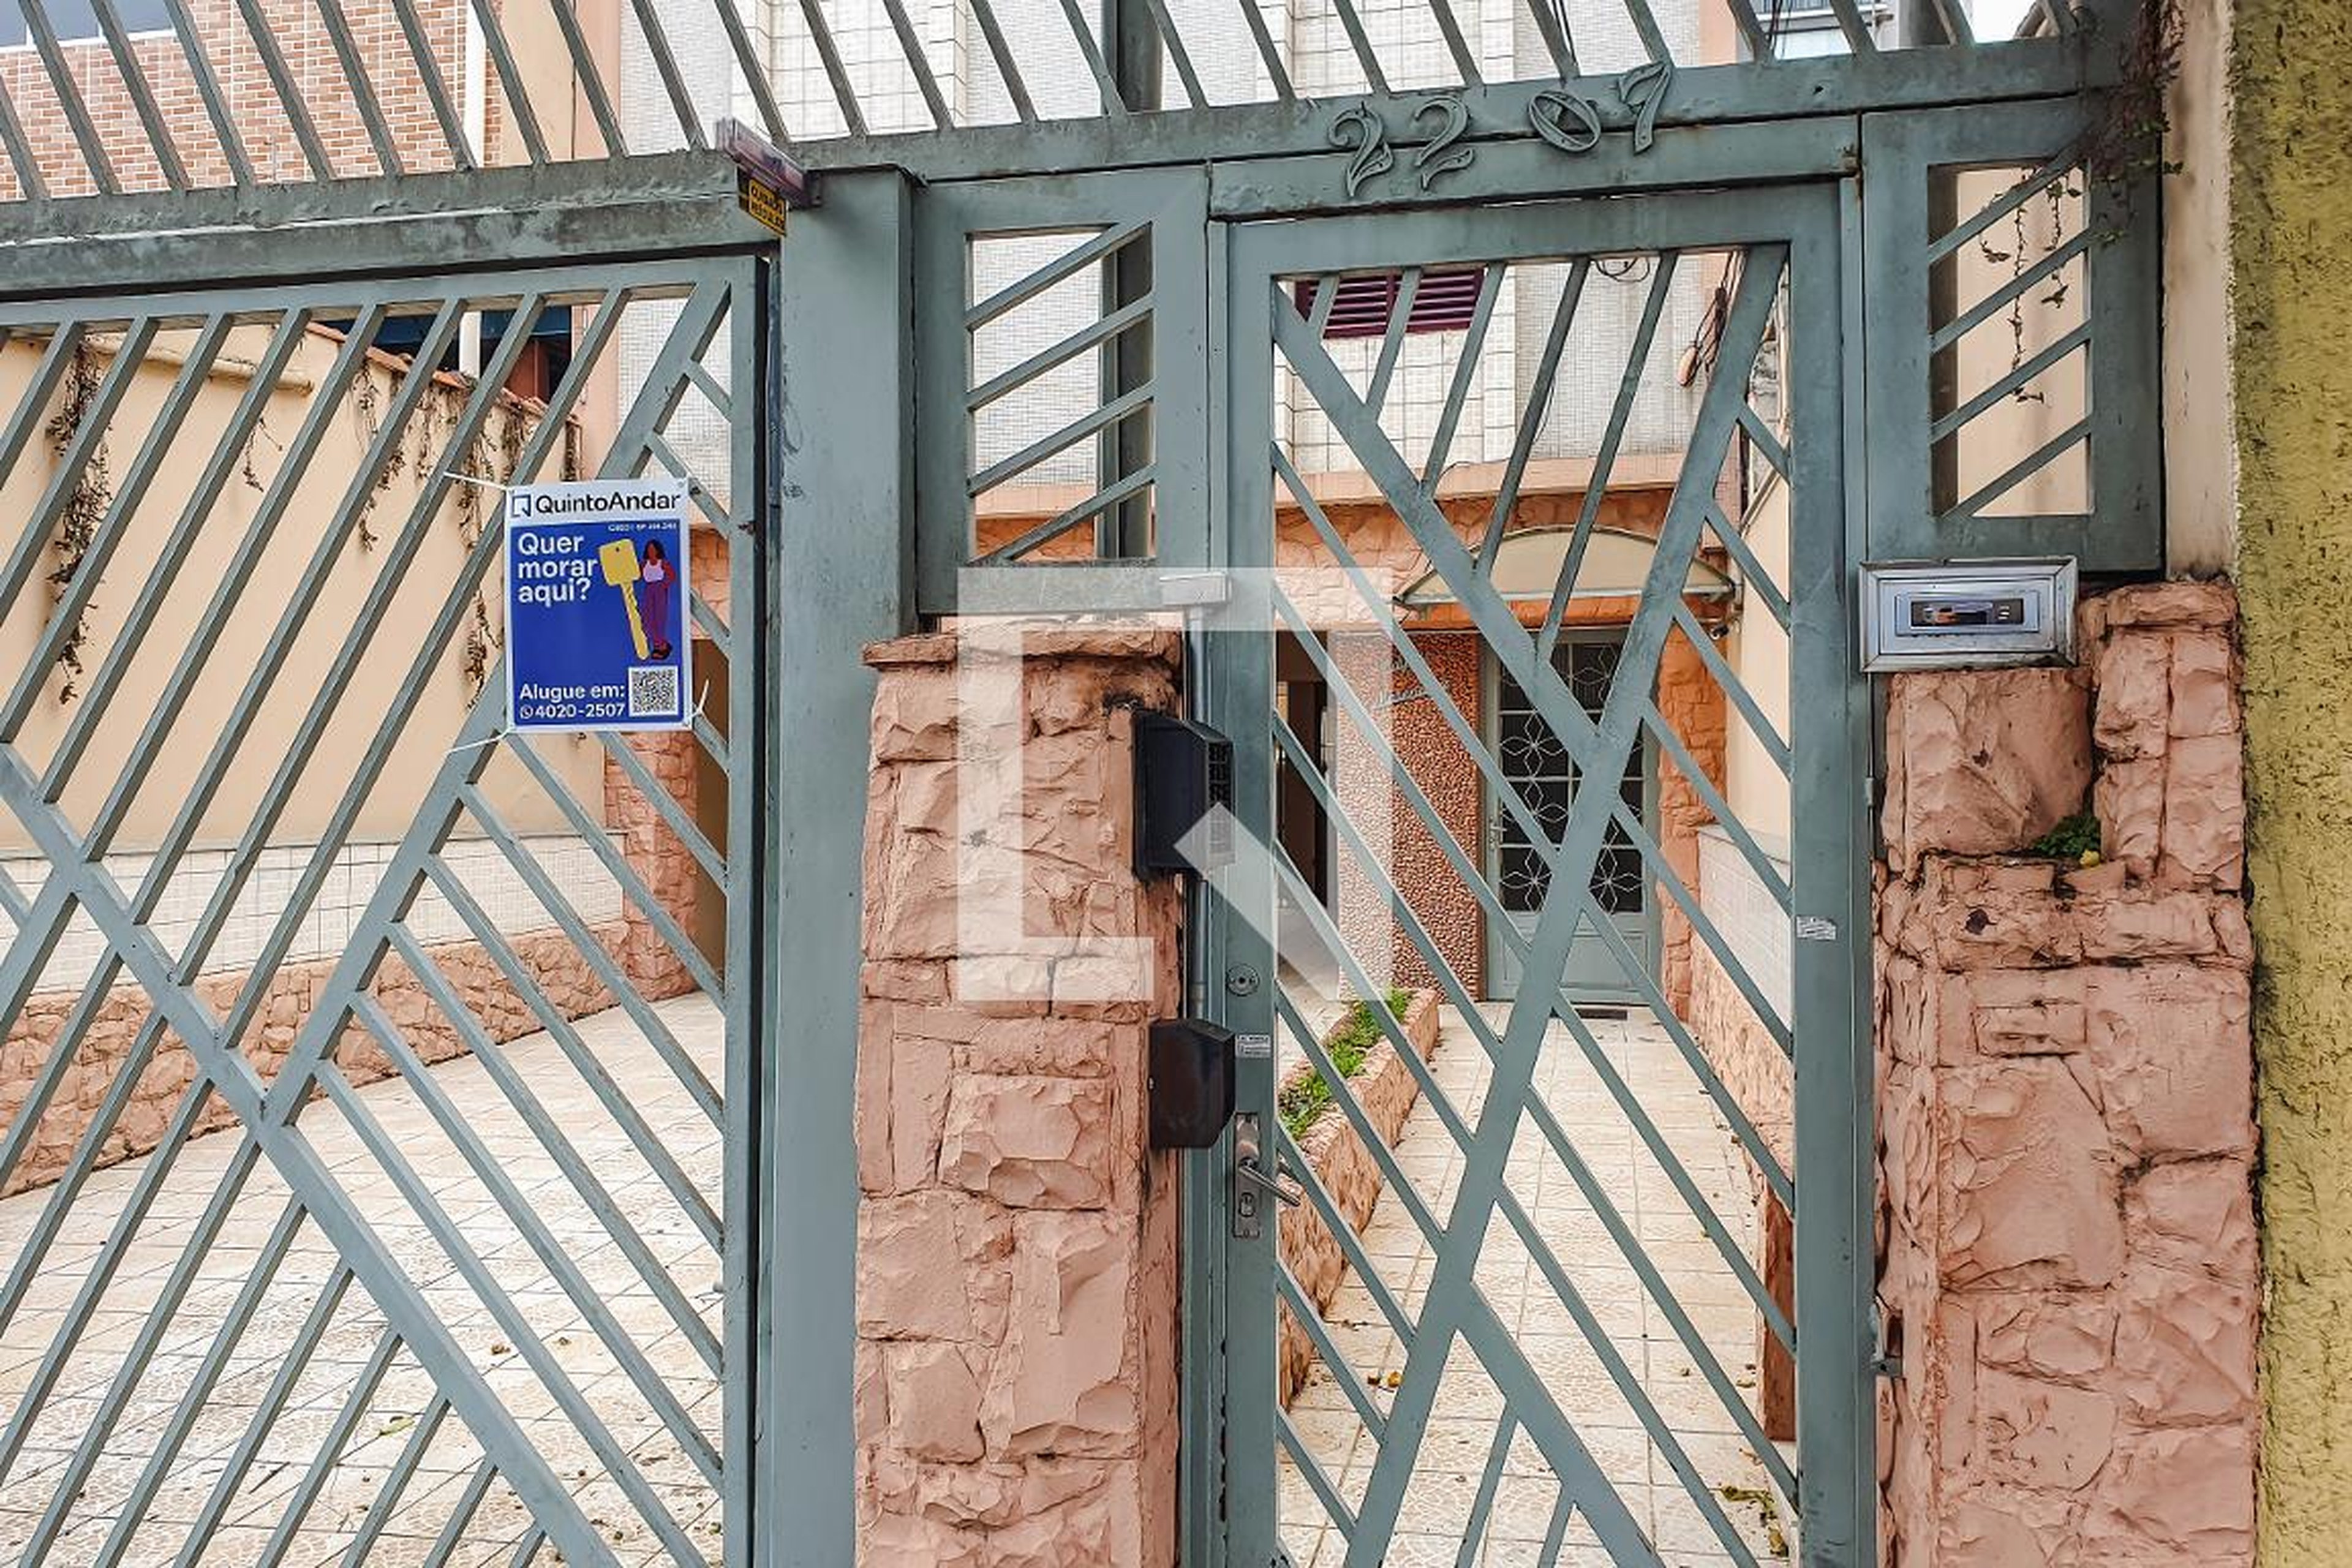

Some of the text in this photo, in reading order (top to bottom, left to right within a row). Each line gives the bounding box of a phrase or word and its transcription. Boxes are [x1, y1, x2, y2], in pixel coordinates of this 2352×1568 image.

[535, 491, 680, 513] QuintoAndar
[518, 532, 584, 556] Quer
[518, 558, 598, 578] morar
[518, 578, 591, 607] aqui?
[520, 684, 625, 703] Alugue em:
[535, 704, 625, 718] 4020-2507
